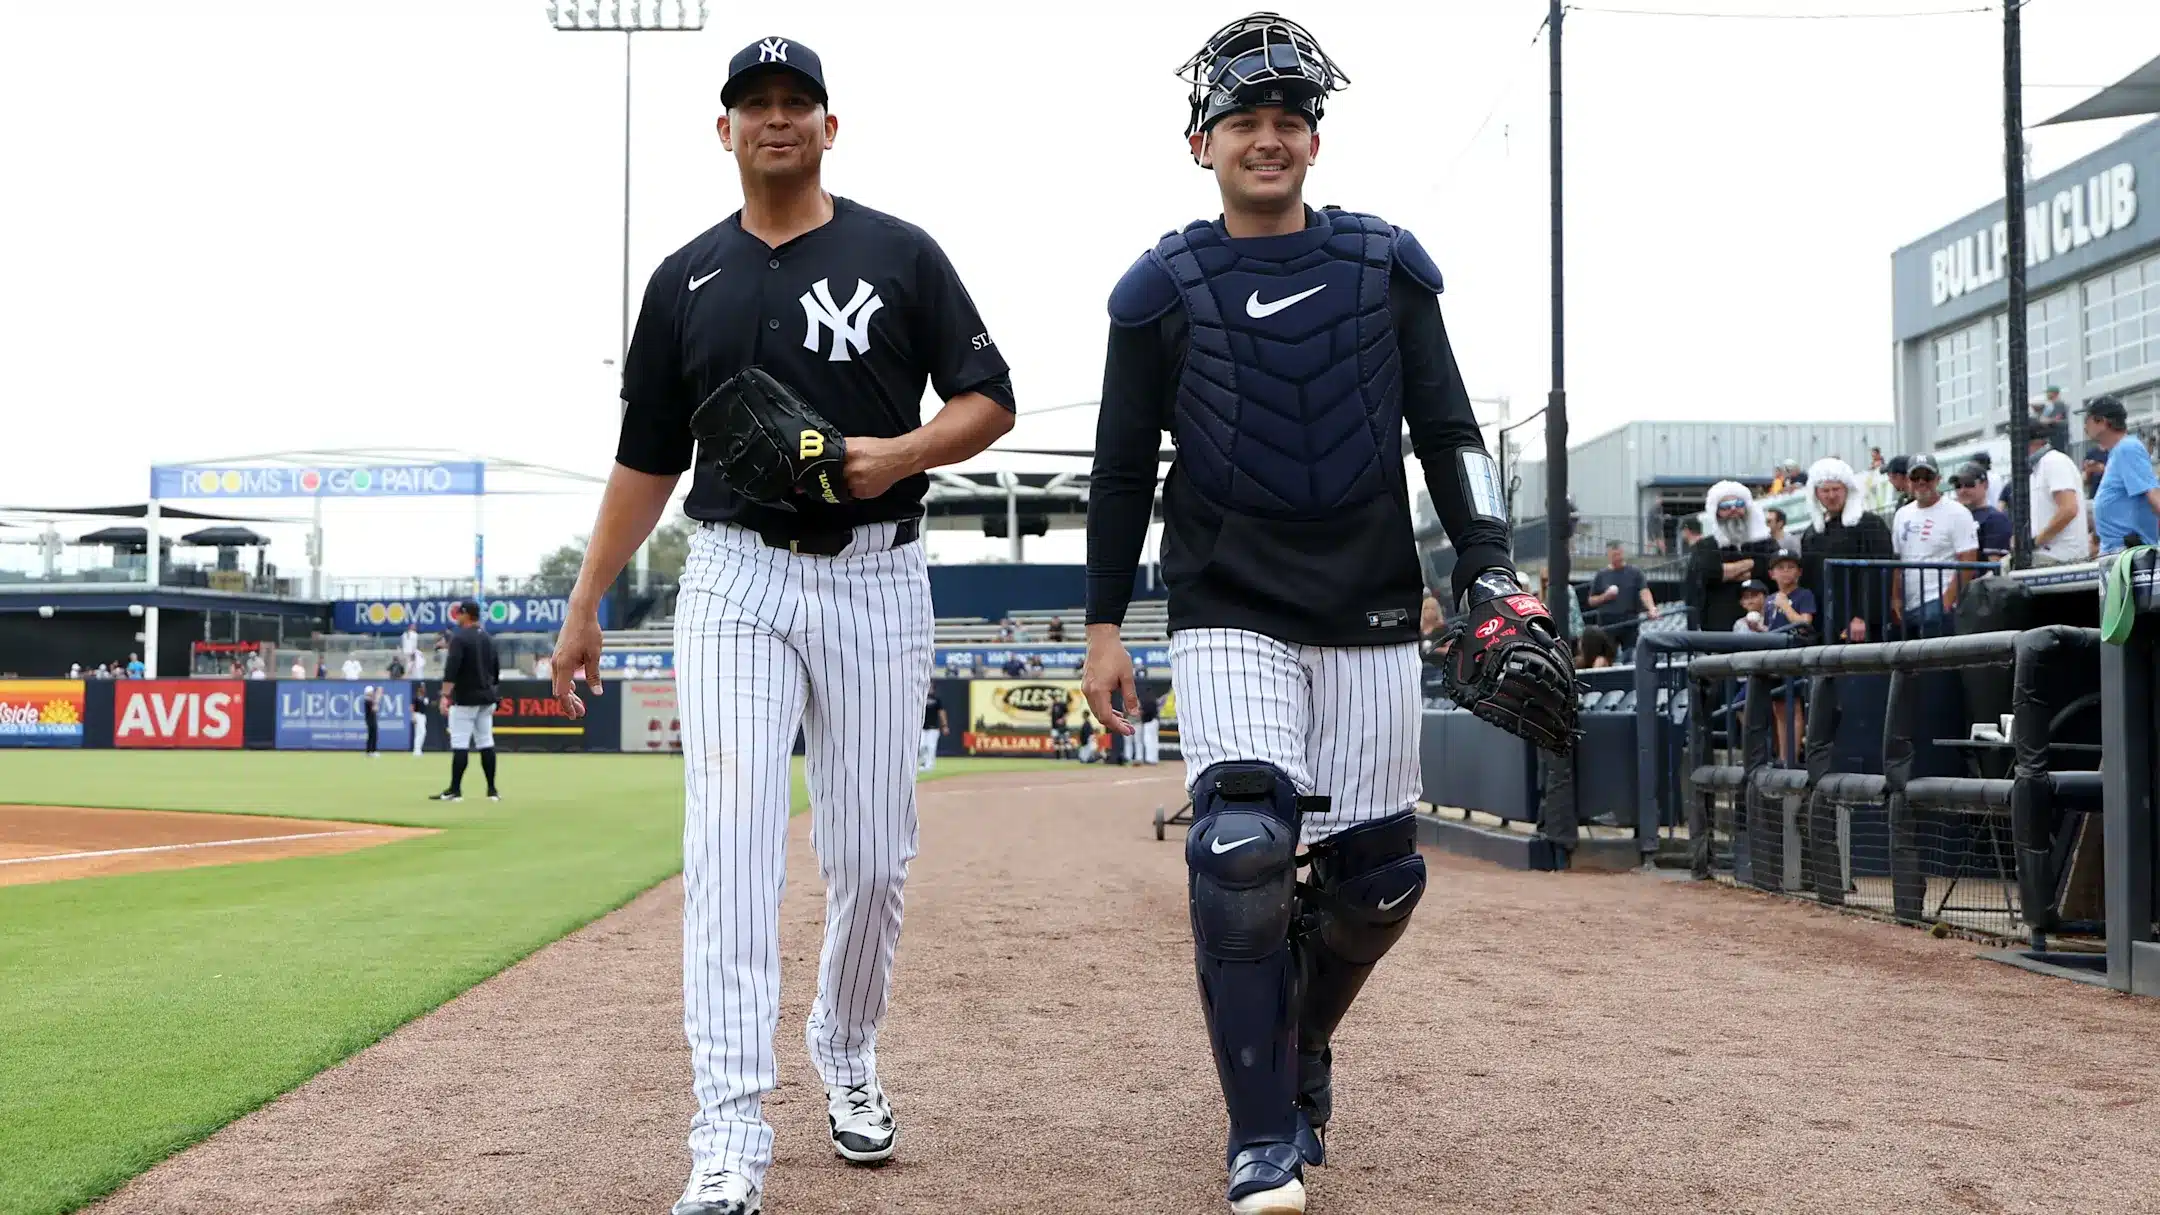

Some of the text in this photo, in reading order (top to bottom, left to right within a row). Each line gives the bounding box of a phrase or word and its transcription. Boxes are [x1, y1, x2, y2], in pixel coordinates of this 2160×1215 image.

[758, 38, 788, 62] NY
[1931, 163, 2138, 307] BULLPN CLUB
[799, 277, 884, 361] NY
[181, 467, 451, 494] ROOMS TO GO PATIO
[355, 602, 435, 625] ROOMS
[117, 692, 232, 739] AVIS
[519, 698, 567, 717] FAR
